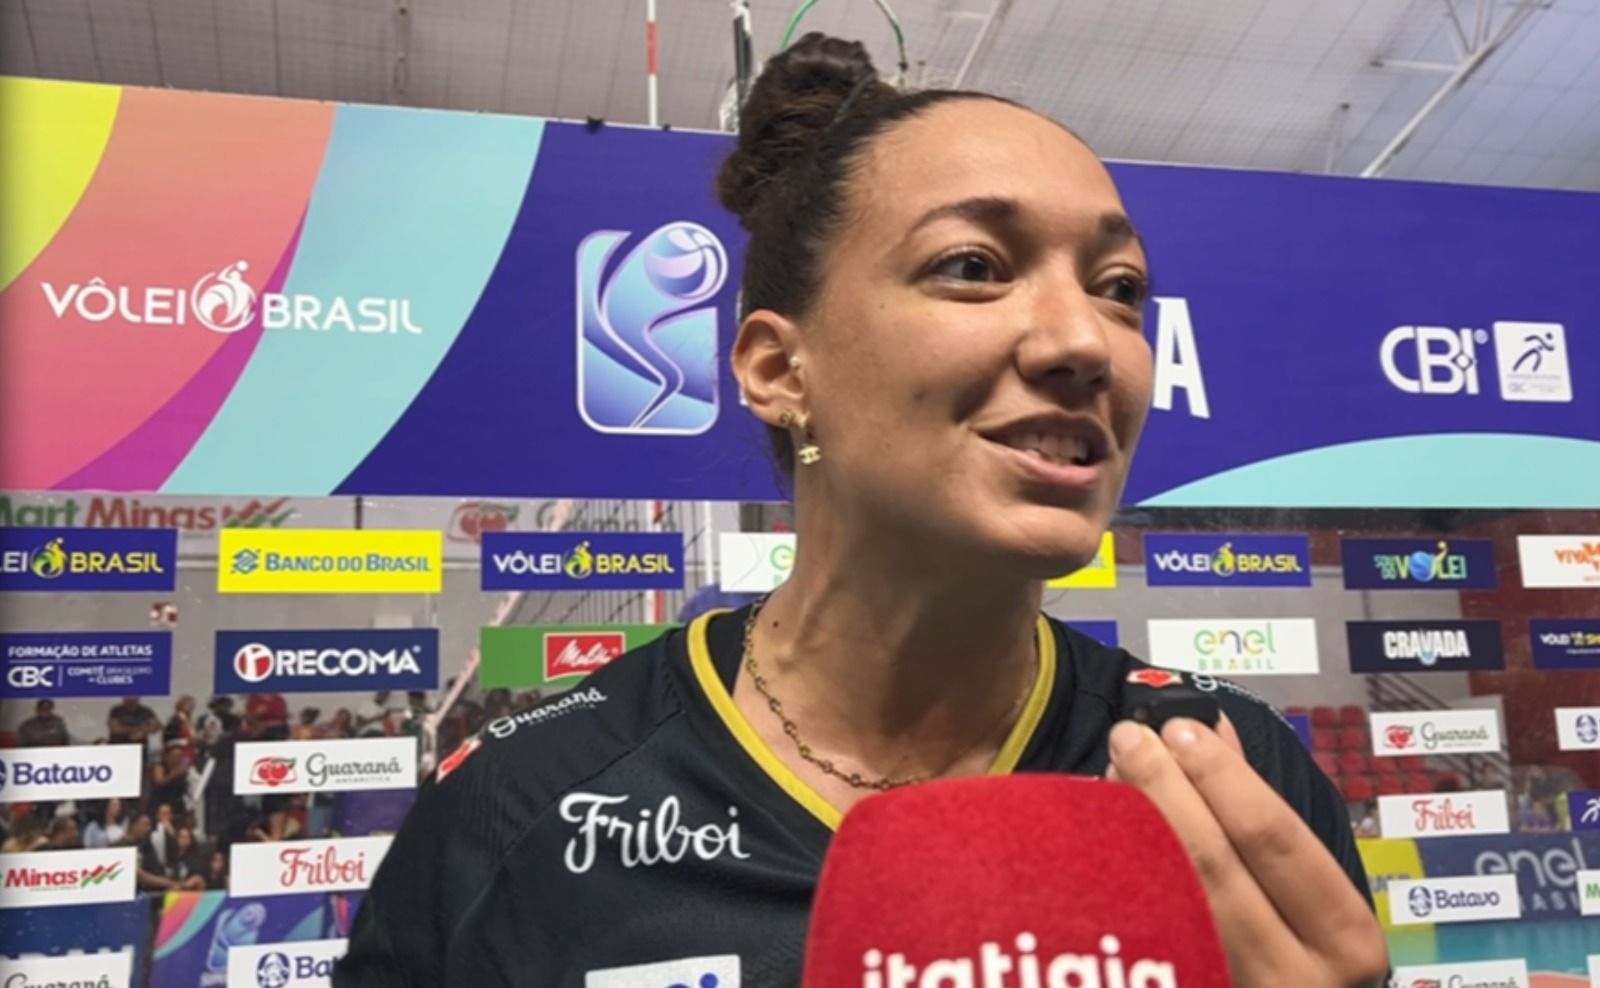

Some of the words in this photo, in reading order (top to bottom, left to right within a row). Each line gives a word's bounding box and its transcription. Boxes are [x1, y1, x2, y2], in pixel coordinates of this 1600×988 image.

[41, 277, 186, 325] VÔLEI
[262, 293, 423, 334] BRASIL
[85, 498, 216, 529] Minas
[70, 552, 164, 573] BRASIL
[265, 552, 335, 572] BANCO
[337, 556, 363, 572] DO
[366, 553, 432, 572] BRASIL
[493, 550, 562, 574] VÔLEI
[596, 554, 675, 574] BRASIL
[1154, 550, 1210, 572] VÔLEI
[1238, 554, 1302, 573] BRASIL
[8, 644, 79, 658] FORMAÇÃO
[82, 645, 98, 656] DE
[100, 644, 153, 656] ATLETAS
[1194, 623, 1276, 656] enel
[1383, 629, 1471, 666] CRAVADA
[276, 648, 421, 676] RECOMA
[1199, 659, 1275, 670] BRASIL
[7, 665, 54, 688] CBC
[1420, 721, 1489, 750] Guaraná
[12, 763, 113, 786] Batavo
[305, 753, 403, 787] Guaraná
[1412, 798, 1476, 831] Friboi
[559, 792, 751, 873] Friboi
[5, 868, 78, 887] Minas
[280, 846, 368, 887] Friboi
[1434, 890, 1500, 909] Batavo
